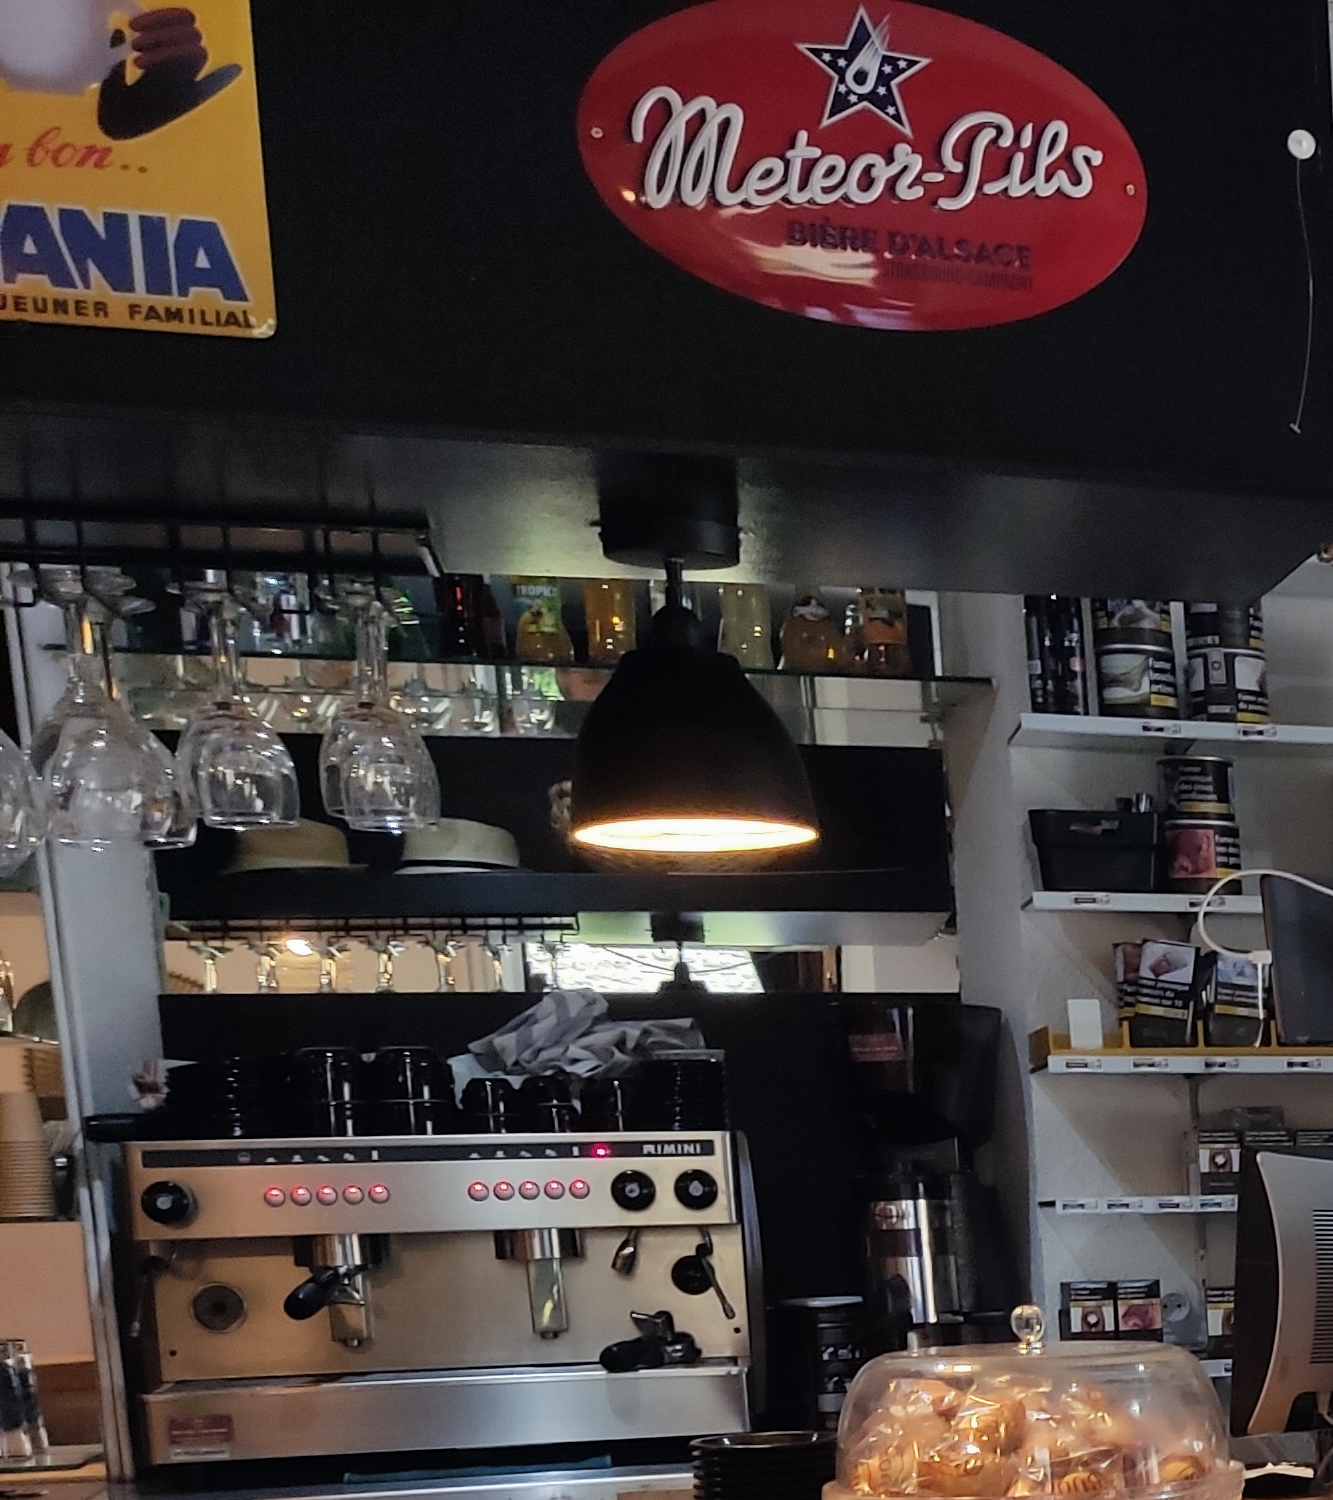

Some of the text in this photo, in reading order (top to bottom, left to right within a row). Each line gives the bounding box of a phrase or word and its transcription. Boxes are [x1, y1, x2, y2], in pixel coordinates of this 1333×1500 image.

[631, 85, 1102, 211] Meteor-Pils
[128, 304, 256, 328] FAMILIAL
[643, 1143, 701, 1155] RIMINI
